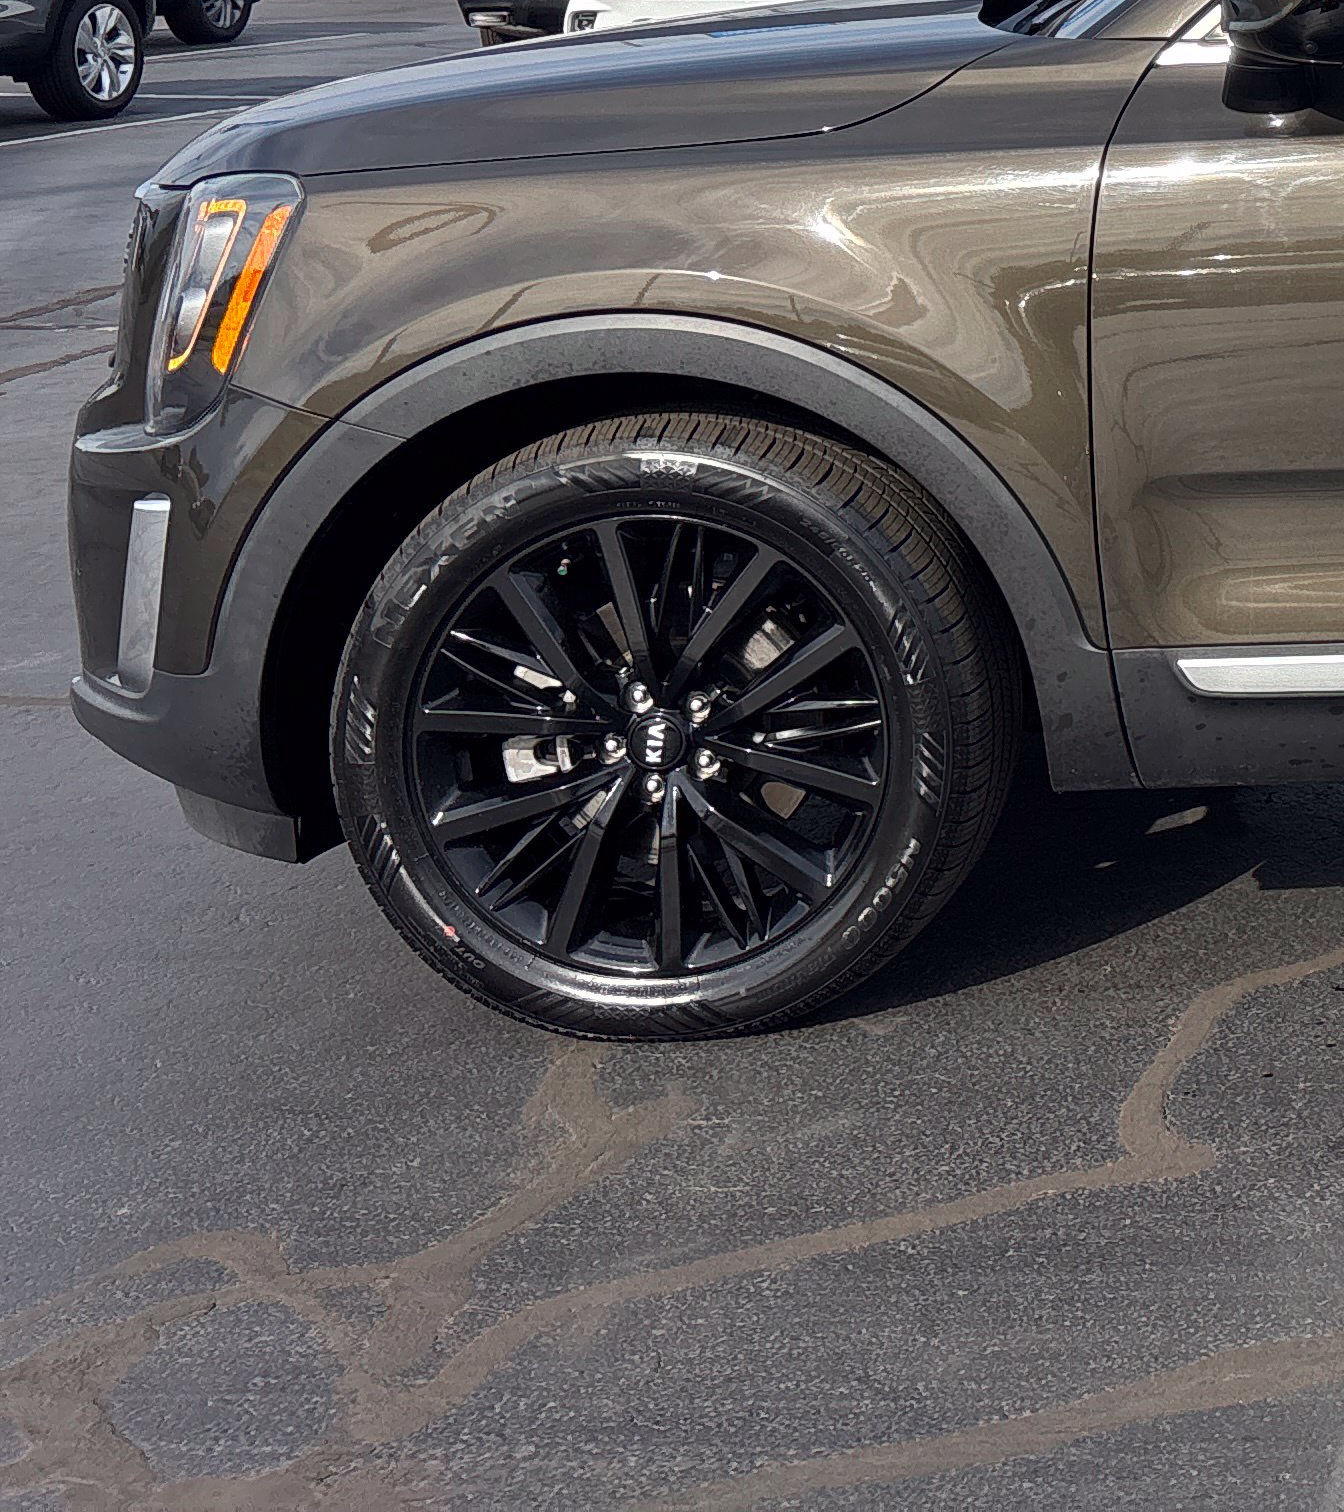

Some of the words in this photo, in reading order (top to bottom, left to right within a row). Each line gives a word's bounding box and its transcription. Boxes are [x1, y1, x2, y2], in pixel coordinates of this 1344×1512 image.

[370, 493, 521, 649] NEXEN
[645, 723, 666, 763] KIA
[841, 838, 921, 950] N5000
